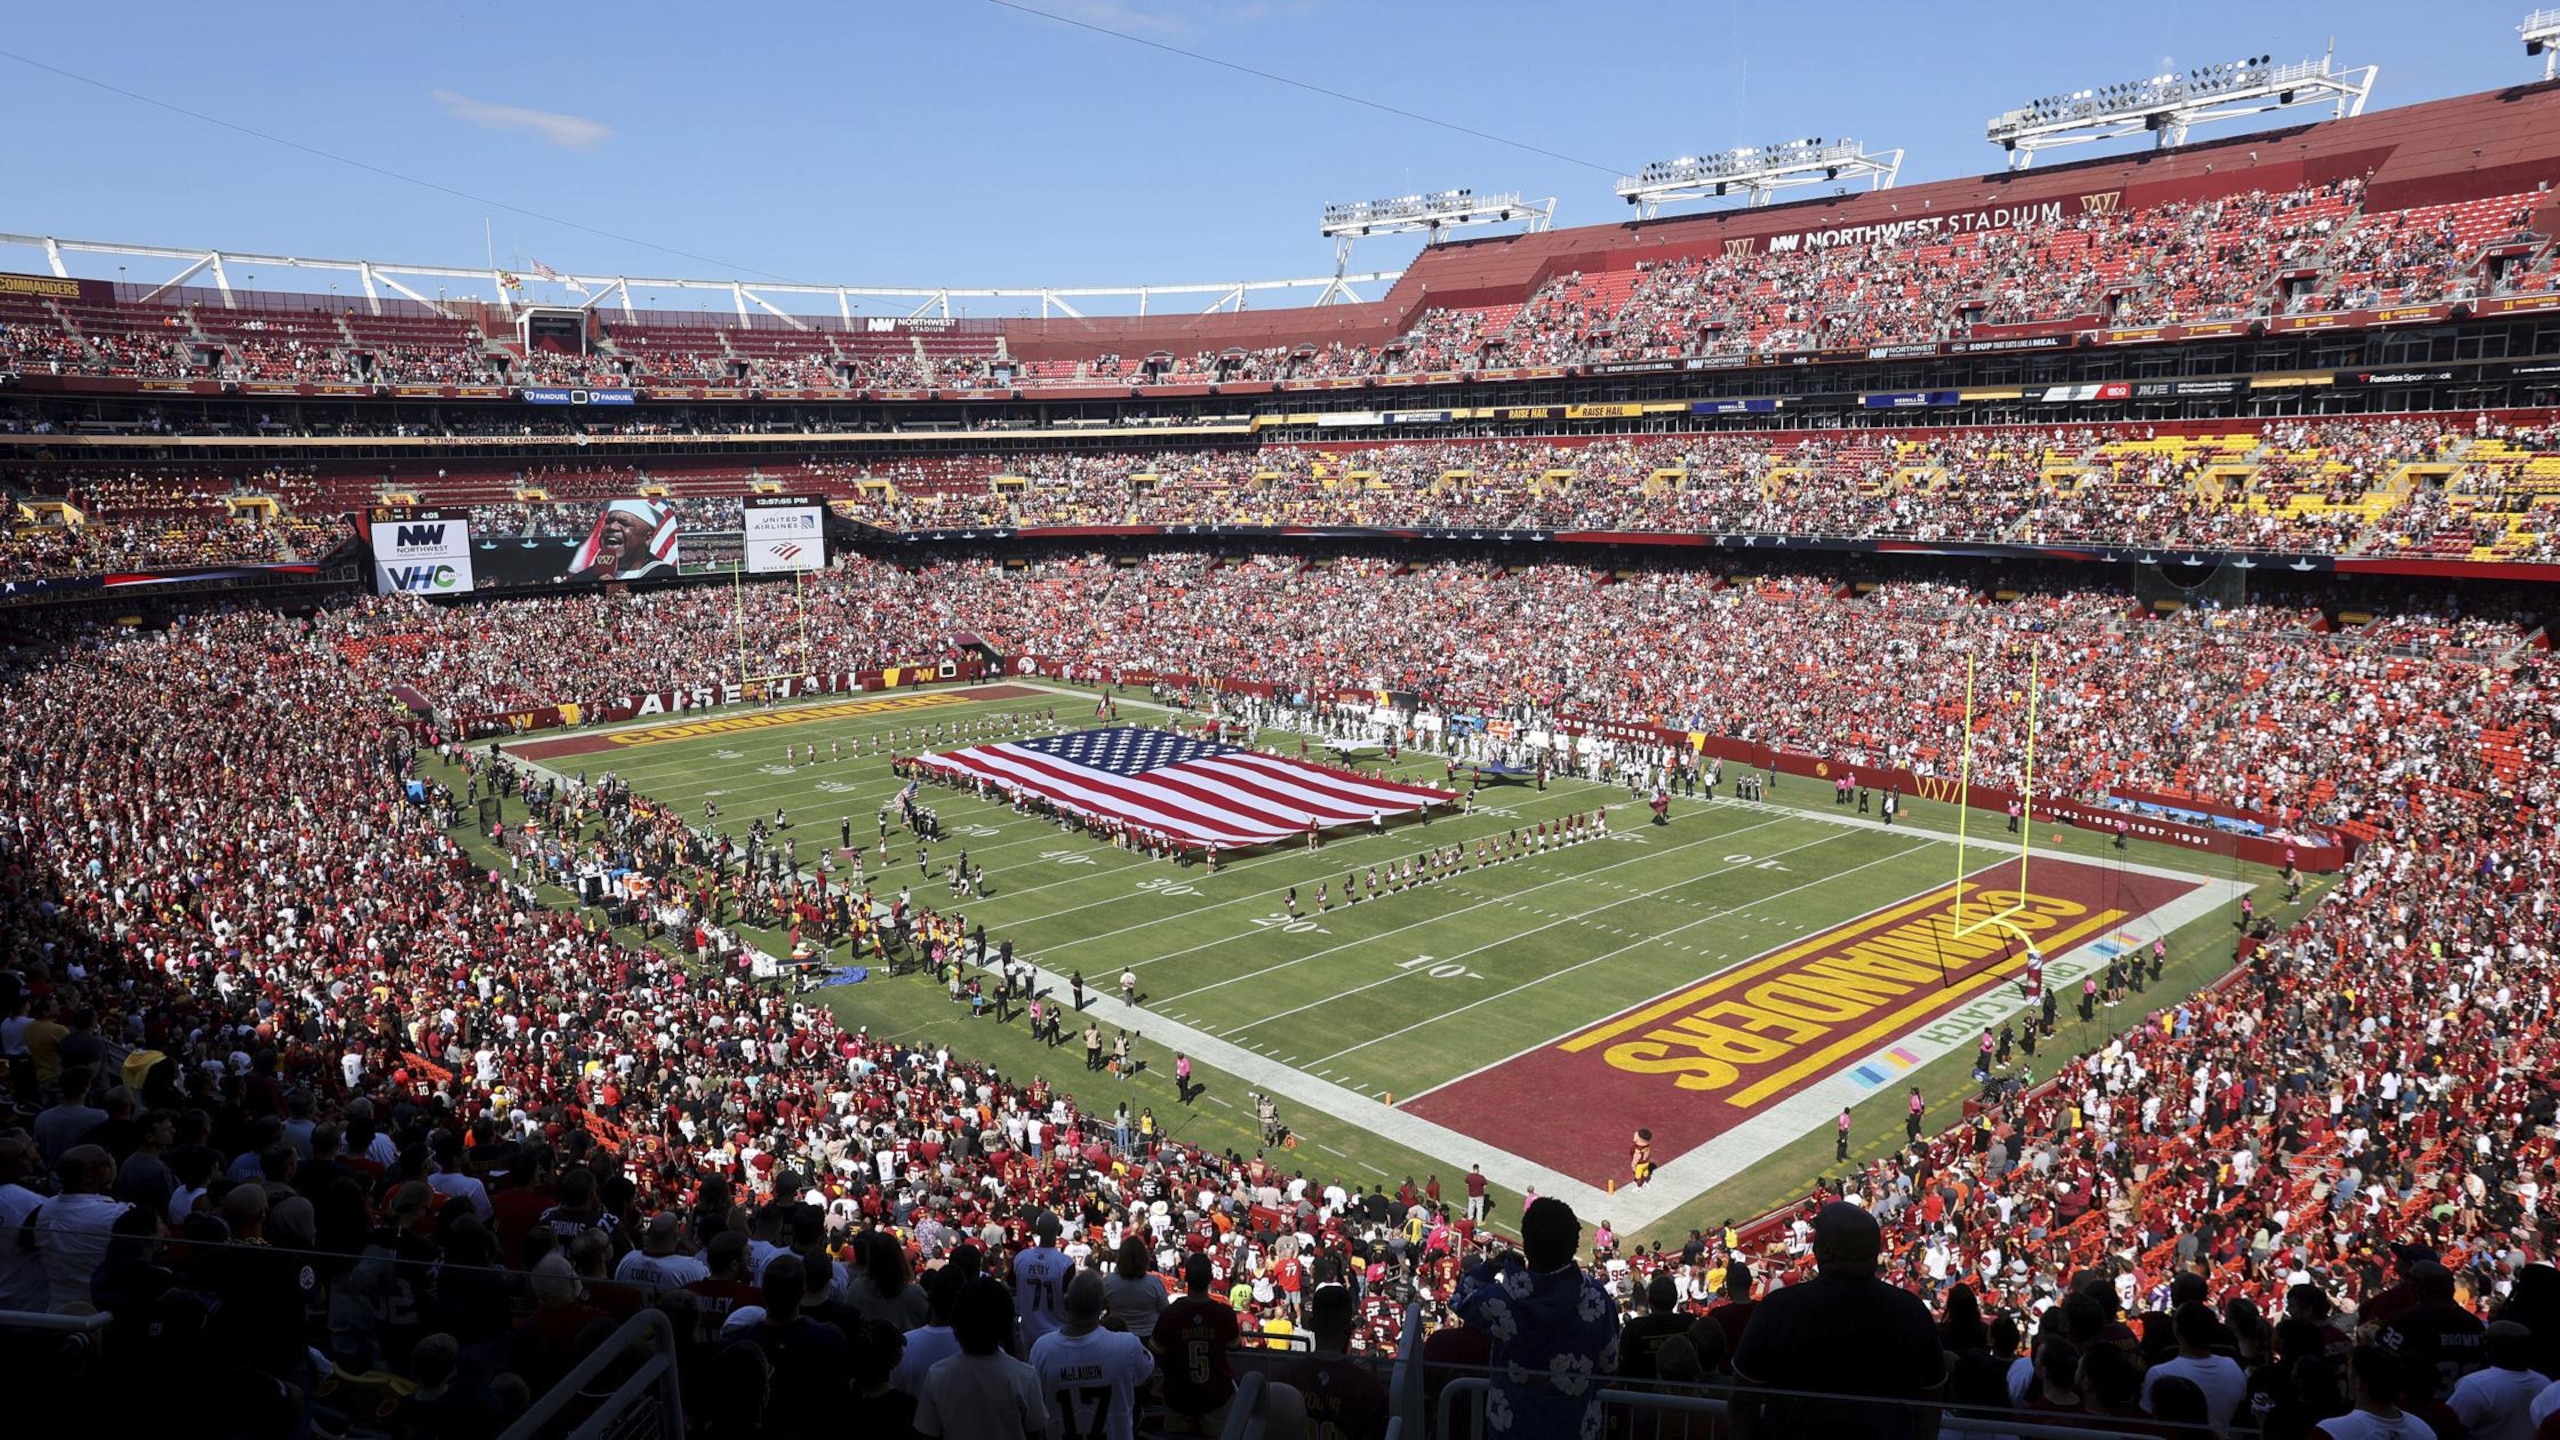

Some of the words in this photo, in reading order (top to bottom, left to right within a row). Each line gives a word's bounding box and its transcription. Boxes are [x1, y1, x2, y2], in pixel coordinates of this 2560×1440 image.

[1806, 217, 1944, 250] NORTHWEST
[1948, 201, 2061, 232] STADIUM
[0, 277, 80, 296] COMMANDERS
[897, 318, 957, 326] NORTHWEST
[1889, 344, 1937, 353] NORTHWEST
[1969, 342, 1992, 351] SOUP
[2033, 338, 2058, 347] MEAL
[2370, 375, 2403, 384] Fanatics
[536, 393, 568, 401] FANDUEL
[601, 393, 633, 401] FANDUEL
[1508, 409, 1530, 419] RAISE
[1531, 408, 1549, 418] HAIL
[1583, 407, 1604, 417] RAISE
[1606, 406, 1624, 416] HAIL
[421, 511, 439, 519] 4:05
[397, 524, 445, 547] NW
[396, 545, 448, 553] NORTHWEST
[388, 564, 456, 590] VHC
[607, 694, 970, 745] COMMANDERS
[2046, 807, 2079, 820] 1942
[2131, 823, 2166, 837] 1987
[2175, 831, 2209, 846] 1991
[1039, 850, 1088, 865] 40
[1134, 878, 1195, 896] 30
[1249, 913, 1320, 934] 20
[1393, 954, 1467, 979] 10
[1603, 889, 2087, 1091] COMMANDERS
[1918, 1001, 2009, 1046] CATCH
[417, 1086, 430, 1096] 10
[1143, 1184, 1156, 1195] 95
[550, 1219, 587, 1236] THOMAS
[1028, 1264, 1050, 1275] PETRY
[1285, 1265, 1297, 1276] 77
[1611, 1270, 1625, 1281] 95
[1027, 1278, 1055, 1312] 71
[1238, 1289, 1248, 1298] 41
[1182, 1327, 1216, 1340] DANIELS
[2382, 1325, 2403, 1351] 32
[2440, 1332, 2484, 1347] BROWN
[1187, 1340, 1211, 1384] 5
[1060, 1364, 1103, 1381] McLAURIN
[1056, 1386, 1112, 1440] 17
